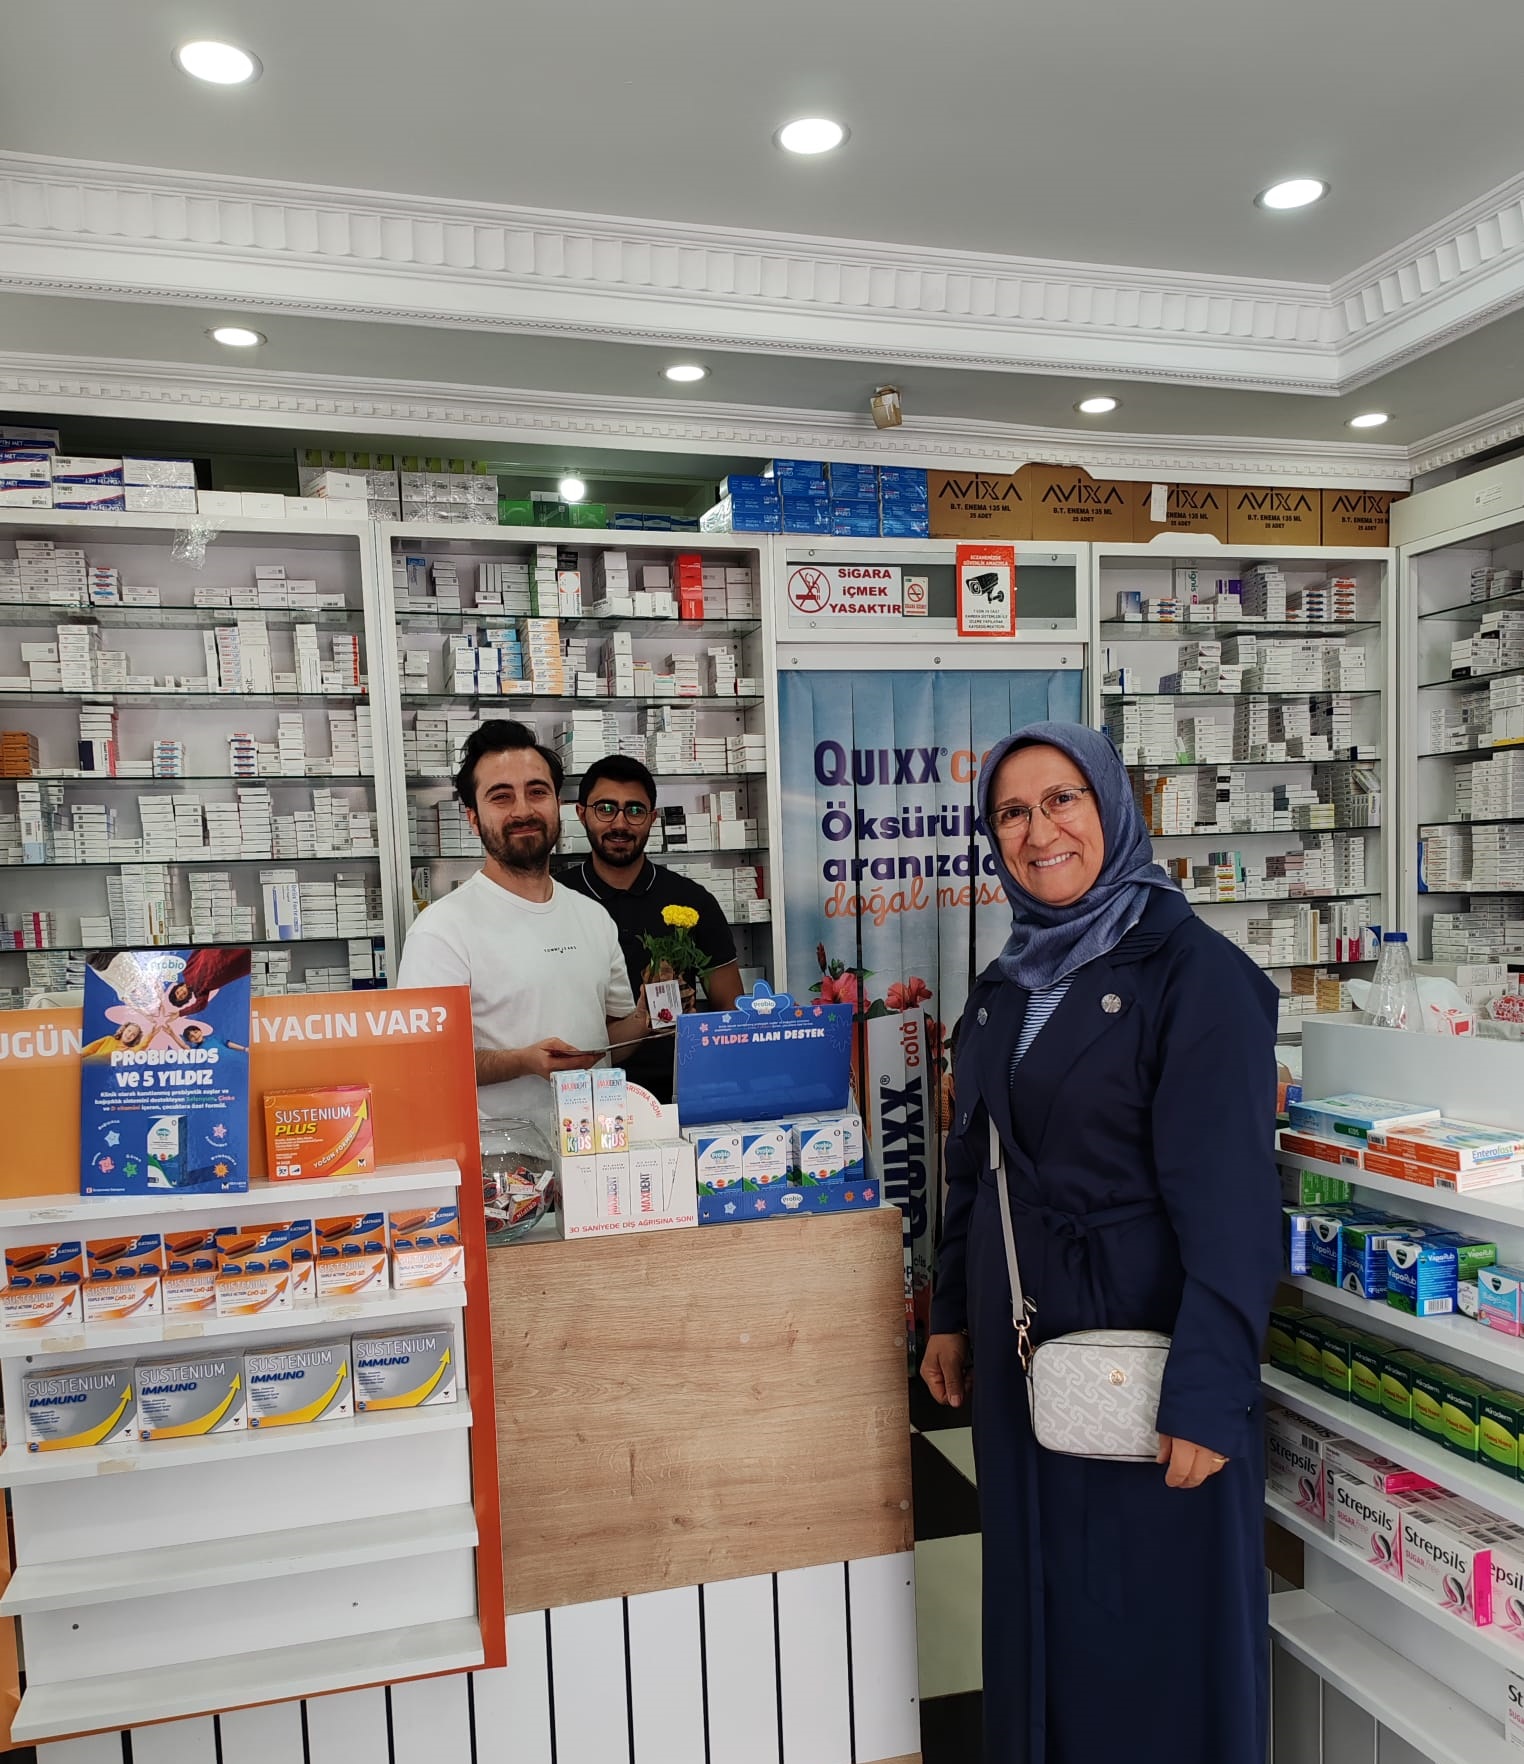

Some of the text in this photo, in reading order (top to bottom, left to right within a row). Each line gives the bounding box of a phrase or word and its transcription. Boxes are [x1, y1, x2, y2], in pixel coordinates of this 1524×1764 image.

[950, 503, 963, 511] B.T.
[965, 503, 987, 511] ENEMA
[829, 603, 902, 614] YASAKTIR
[822, 801, 987, 841] Öksürük
[365, 1006, 447, 1037] VAR?
[701, 1028, 825, 1046] 5 YILDIZ ALAN DESTEK
[111, 1048, 220, 1067] PROBIOKIDS
[143, 1071, 154, 1087] 5
[157, 1069, 214, 1087] YILDIZ
[275, 1106, 351, 1124] SUSTENIUM
[275, 1122, 317, 1136] PLUS
[357, 1337, 437, 1358] SUSTENIUM
[249, 1350, 333, 1373] SUSTENIUM
[358, 1355, 410, 1368] IMMUNO
[140, 1362, 226, 1385] SUSTENIUM
[251, 1370, 305, 1384] IMMUNO
[28, 1374, 116, 1397] SUSTENIUM
[141, 1381, 197, 1396] IMMUNO
[29, 1393, 87, 1408] IMMUNO
[1270, 1437, 1317, 1475] Strepsils
[1337, 1487, 1394, 1532] Strepsils
[1404, 1525, 1467, 1575] Strepsils
